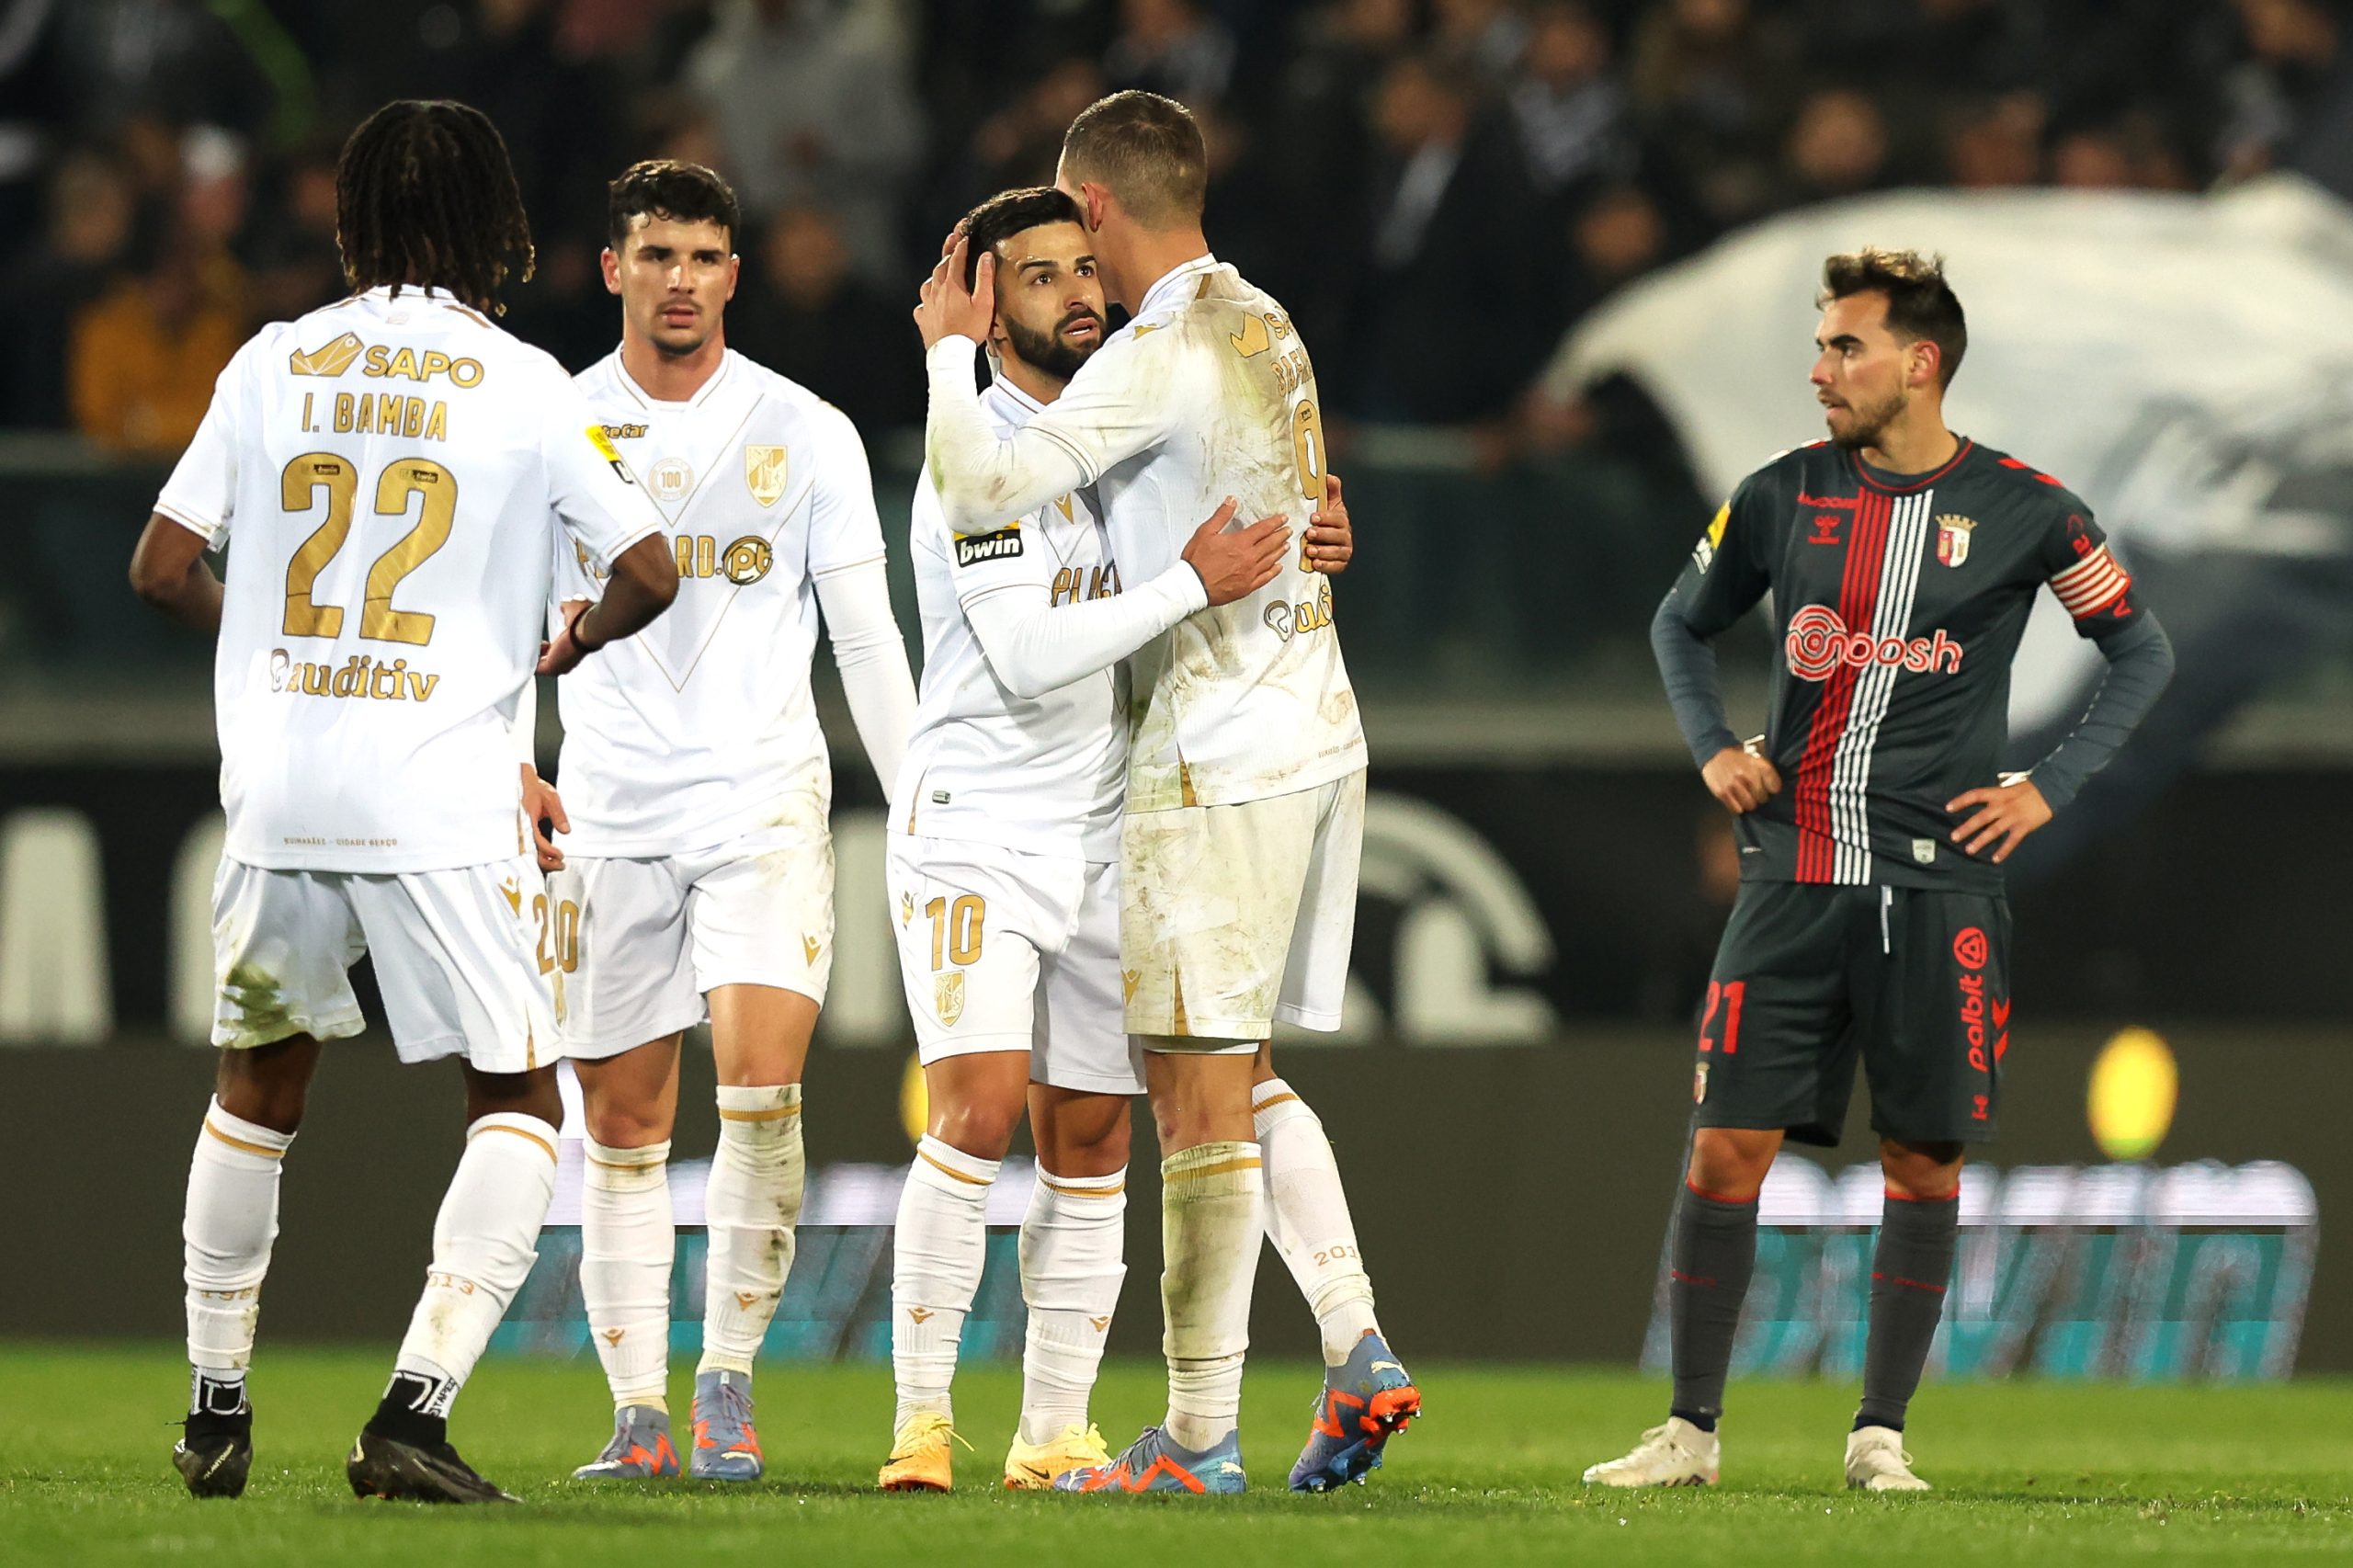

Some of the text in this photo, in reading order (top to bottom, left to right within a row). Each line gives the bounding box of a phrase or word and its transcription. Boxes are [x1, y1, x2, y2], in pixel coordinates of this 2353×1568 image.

[363, 345, 484, 389] SAPO
[301, 392, 448, 441] I. BAMBA
[281, 451, 459, 647] 22
[960, 533, 1021, 565] bwin
[532, 892, 580, 976] 20
[925, 894, 986, 971] 10
[1697, 980, 1746, 1054] 21
[1958, 973, 1989, 1074] palbit
[1313, 1245, 1358, 1267] 201
